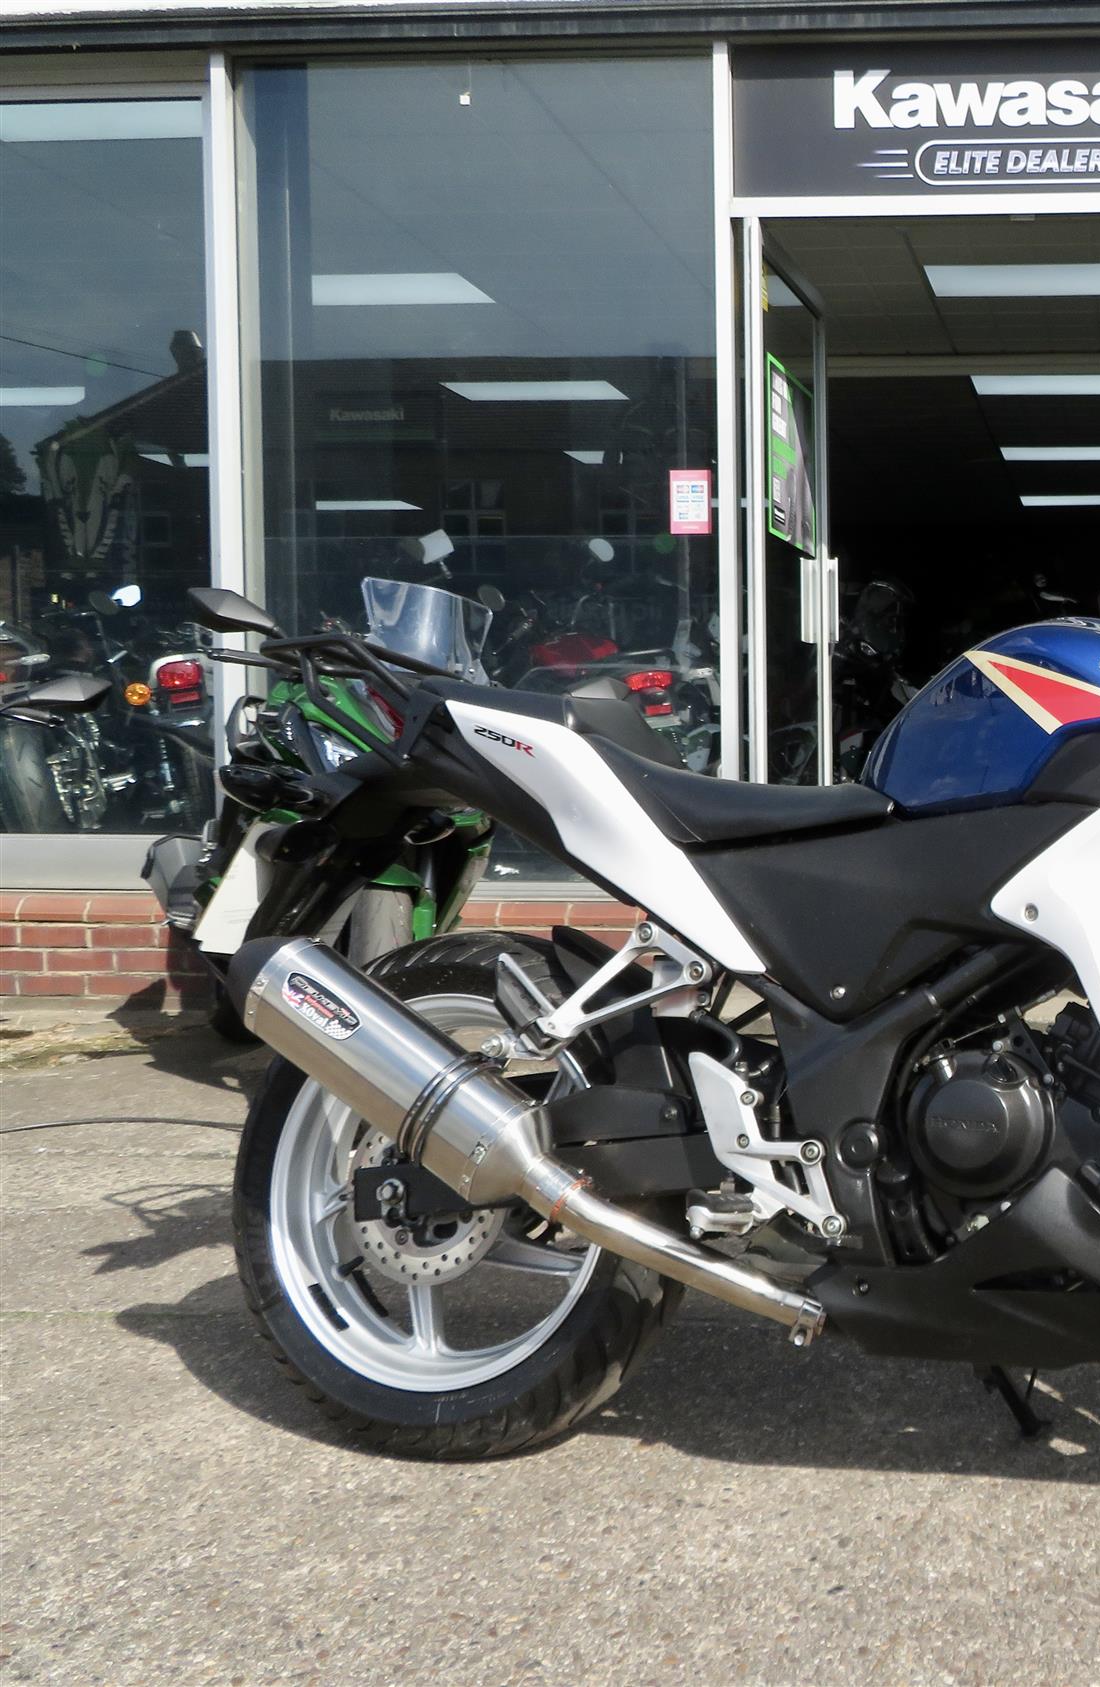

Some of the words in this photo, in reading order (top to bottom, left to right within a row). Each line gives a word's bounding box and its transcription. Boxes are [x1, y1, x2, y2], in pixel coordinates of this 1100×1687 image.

[934, 150, 1001, 175] ELITE
[329, 407, 404, 421] Kawasaki
[474, 725, 536, 759] 250R
